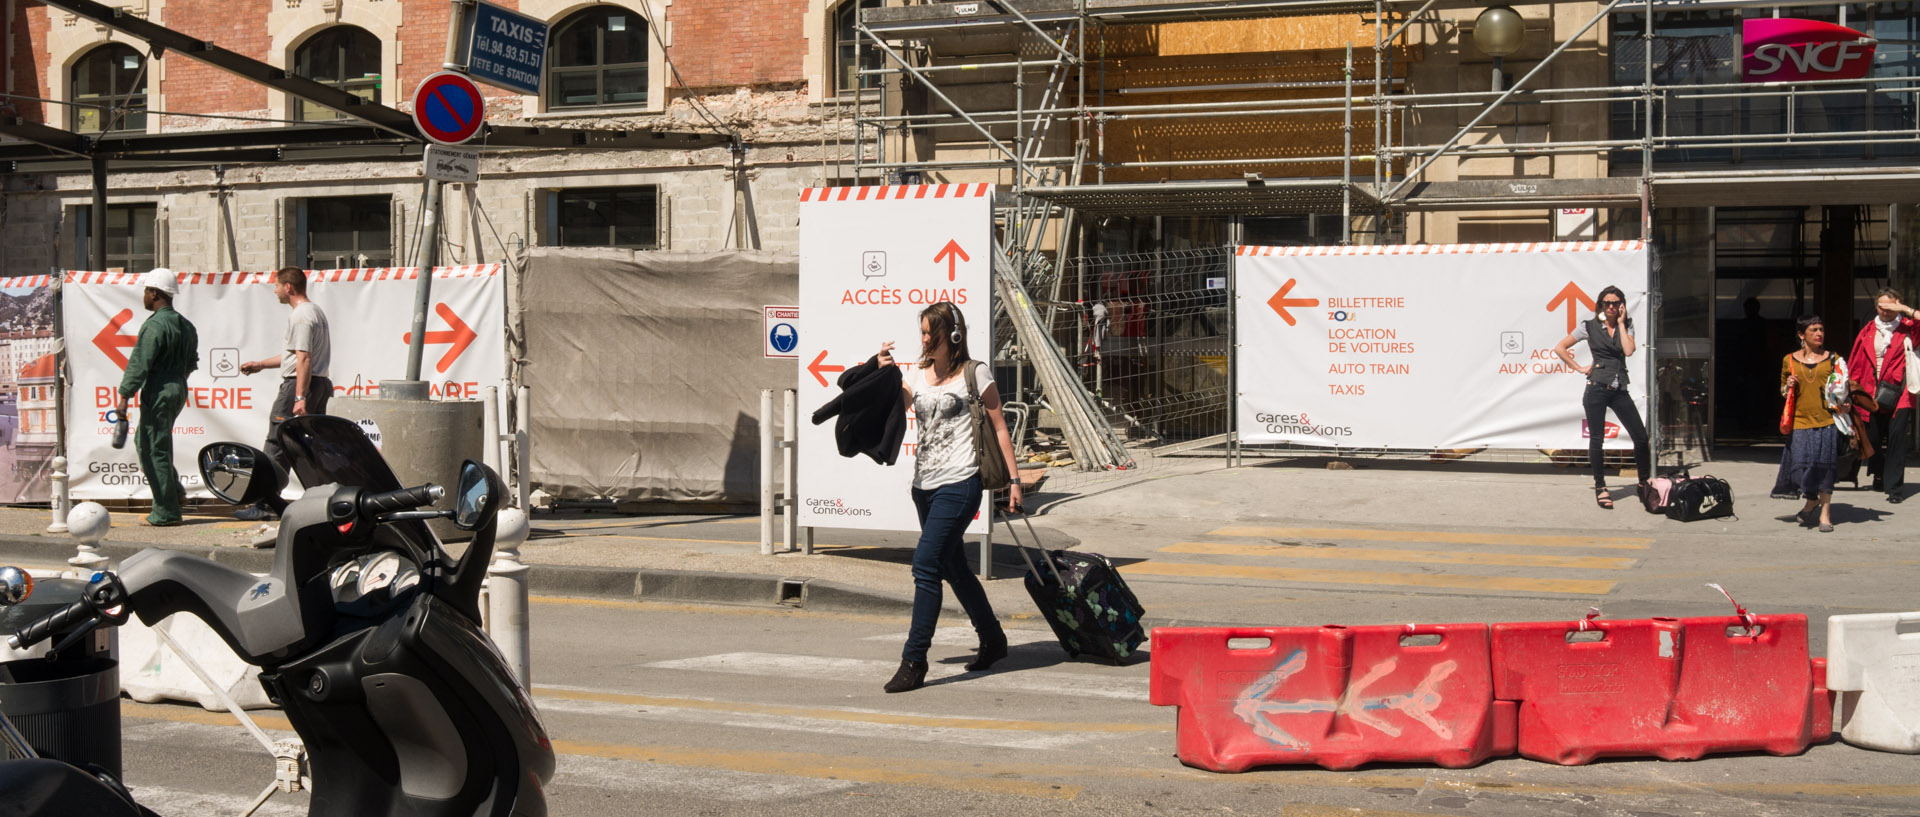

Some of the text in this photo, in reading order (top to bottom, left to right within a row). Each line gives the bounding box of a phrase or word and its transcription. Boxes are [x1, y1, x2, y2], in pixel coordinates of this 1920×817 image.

[491, 15, 533, 43] TAXIS
[476, 35, 540, 68] Tél.94.93.51.51
[1749, 40, 1865, 75] SNCF
[493, 63, 504, 75] DE
[506, 68, 539, 86] STATION
[841, 285, 967, 305] ACCÈS QUAIS
[1328, 297, 1405, 309] BILLETTERIE
[1328, 328, 1396, 340] LOCATION
[1329, 342, 1415, 353] DE VOITURES
[1530, 348, 1575, 360] ACCS
[1328, 363, 1409, 375] AUTO TRAIN
[1498, 362, 1575, 374] AUX QUAIS
[1328, 384, 1365, 396] TAXIS
[95, 386, 252, 409] BILTERIE
[172, 426, 205, 435] ITURES
[1583, 426, 1618, 437] SCF
[101, 473, 199, 486] Connens
